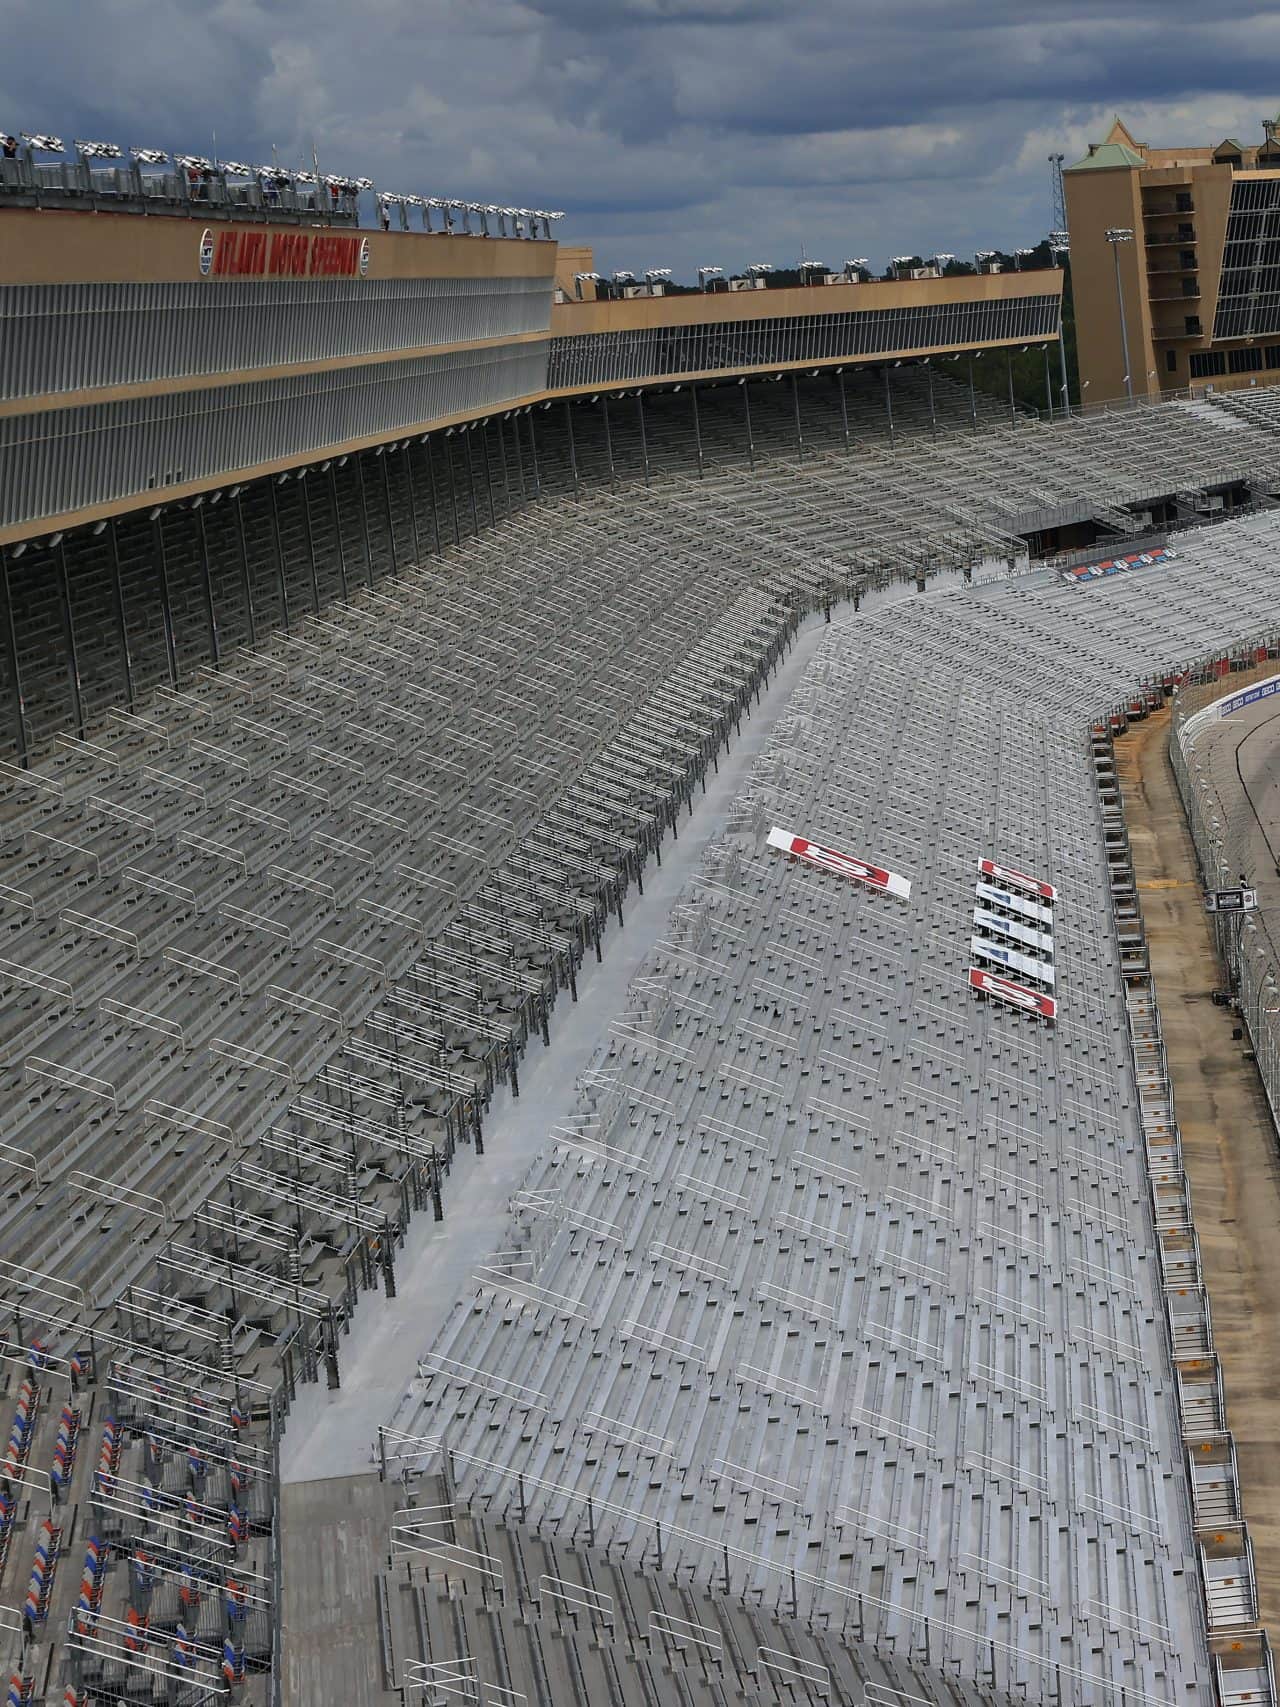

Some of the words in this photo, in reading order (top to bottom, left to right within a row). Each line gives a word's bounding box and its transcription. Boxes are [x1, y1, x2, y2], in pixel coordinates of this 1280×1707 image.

[212, 231, 267, 275] ATLANTA
[268, 234, 308, 275] MOTOR
[309, 235, 361, 276] SPEEDWAY
